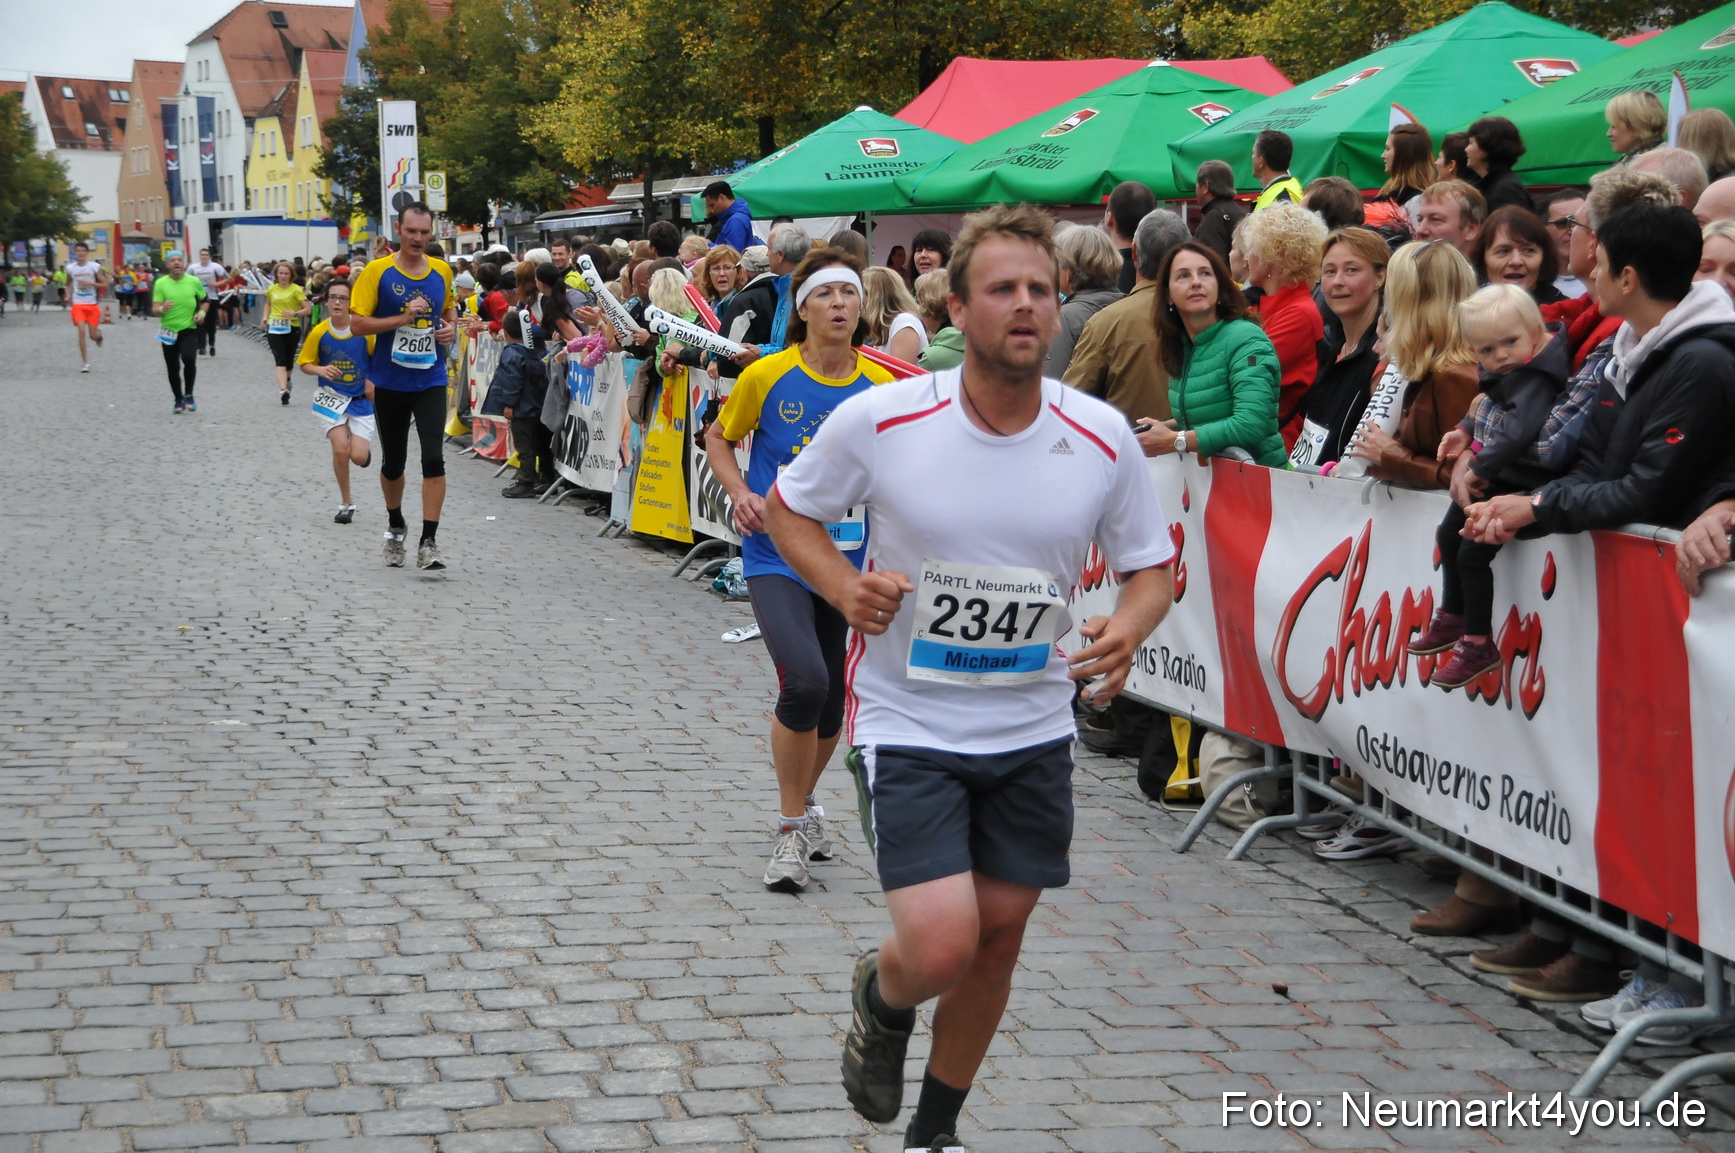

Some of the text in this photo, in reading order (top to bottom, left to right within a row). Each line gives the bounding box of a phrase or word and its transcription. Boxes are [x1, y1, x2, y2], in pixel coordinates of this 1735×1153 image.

[386, 124, 415, 137] swn
[840, 160, 926, 171] Neumarkte
[398, 336, 432, 352] 2602
[674, 329, 704, 346] BMW
[314, 392, 345, 410] 3357
[783, 408, 799, 416] Jahre
[1049, 448, 1075, 456] adidas
[924, 570, 1043, 595] PARTL Neumarkt
[928, 593, 1052, 643] 2347
[944, 650, 1019, 669] Michael
[1160, 645, 1206, 693] Radio
[1356, 724, 1572, 846] Ostbayerns Radio
